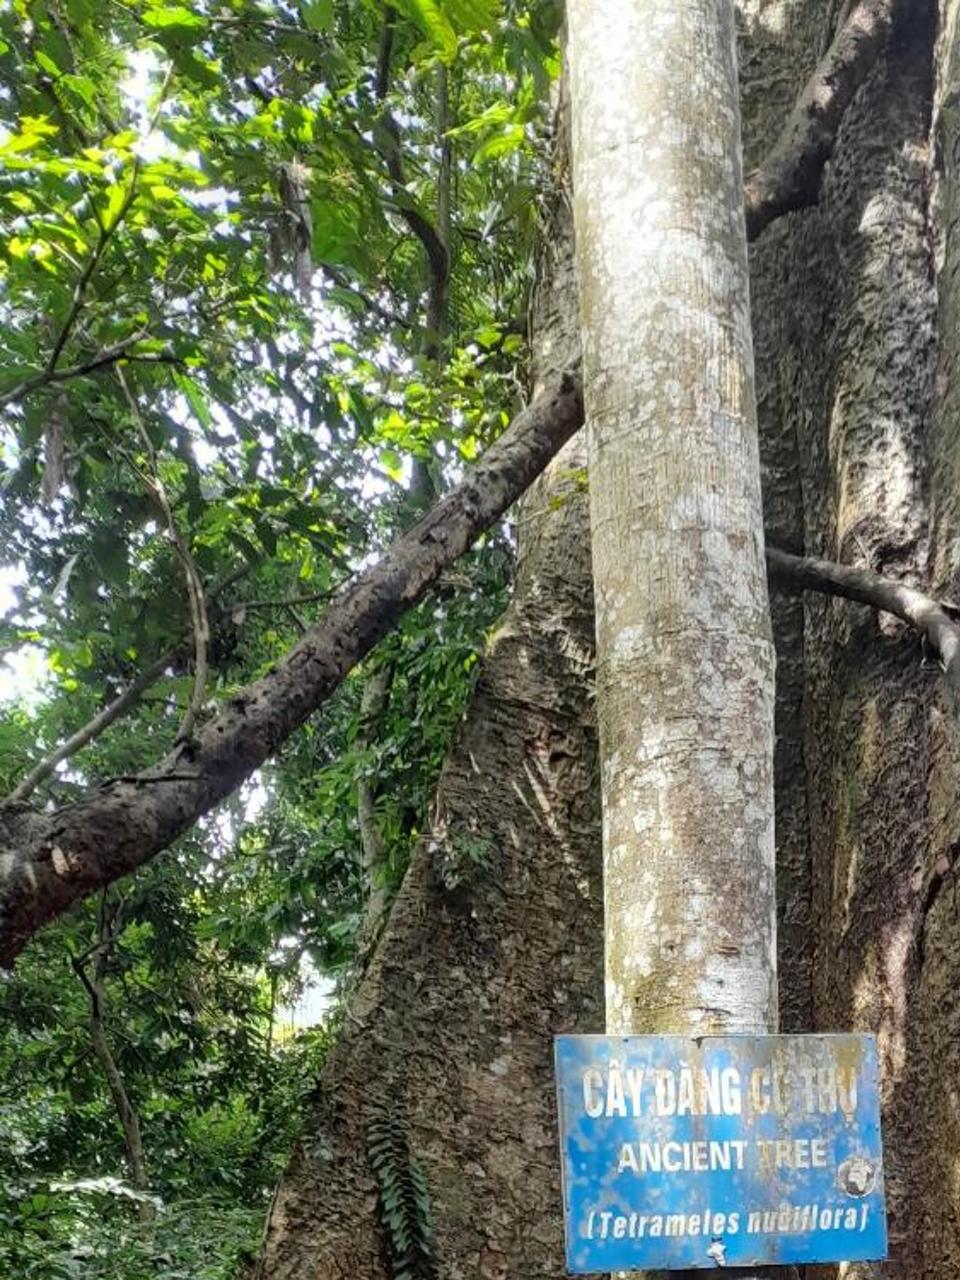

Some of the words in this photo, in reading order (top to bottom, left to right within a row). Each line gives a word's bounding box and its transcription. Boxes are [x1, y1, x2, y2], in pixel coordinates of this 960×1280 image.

[583, 1059, 643, 1116] CÂY
[618, 1141, 747, 1172] ANCIENT
[757, 1138, 827, 1169] TREE
[587, 1209, 739, 1240] (Tetrameles
